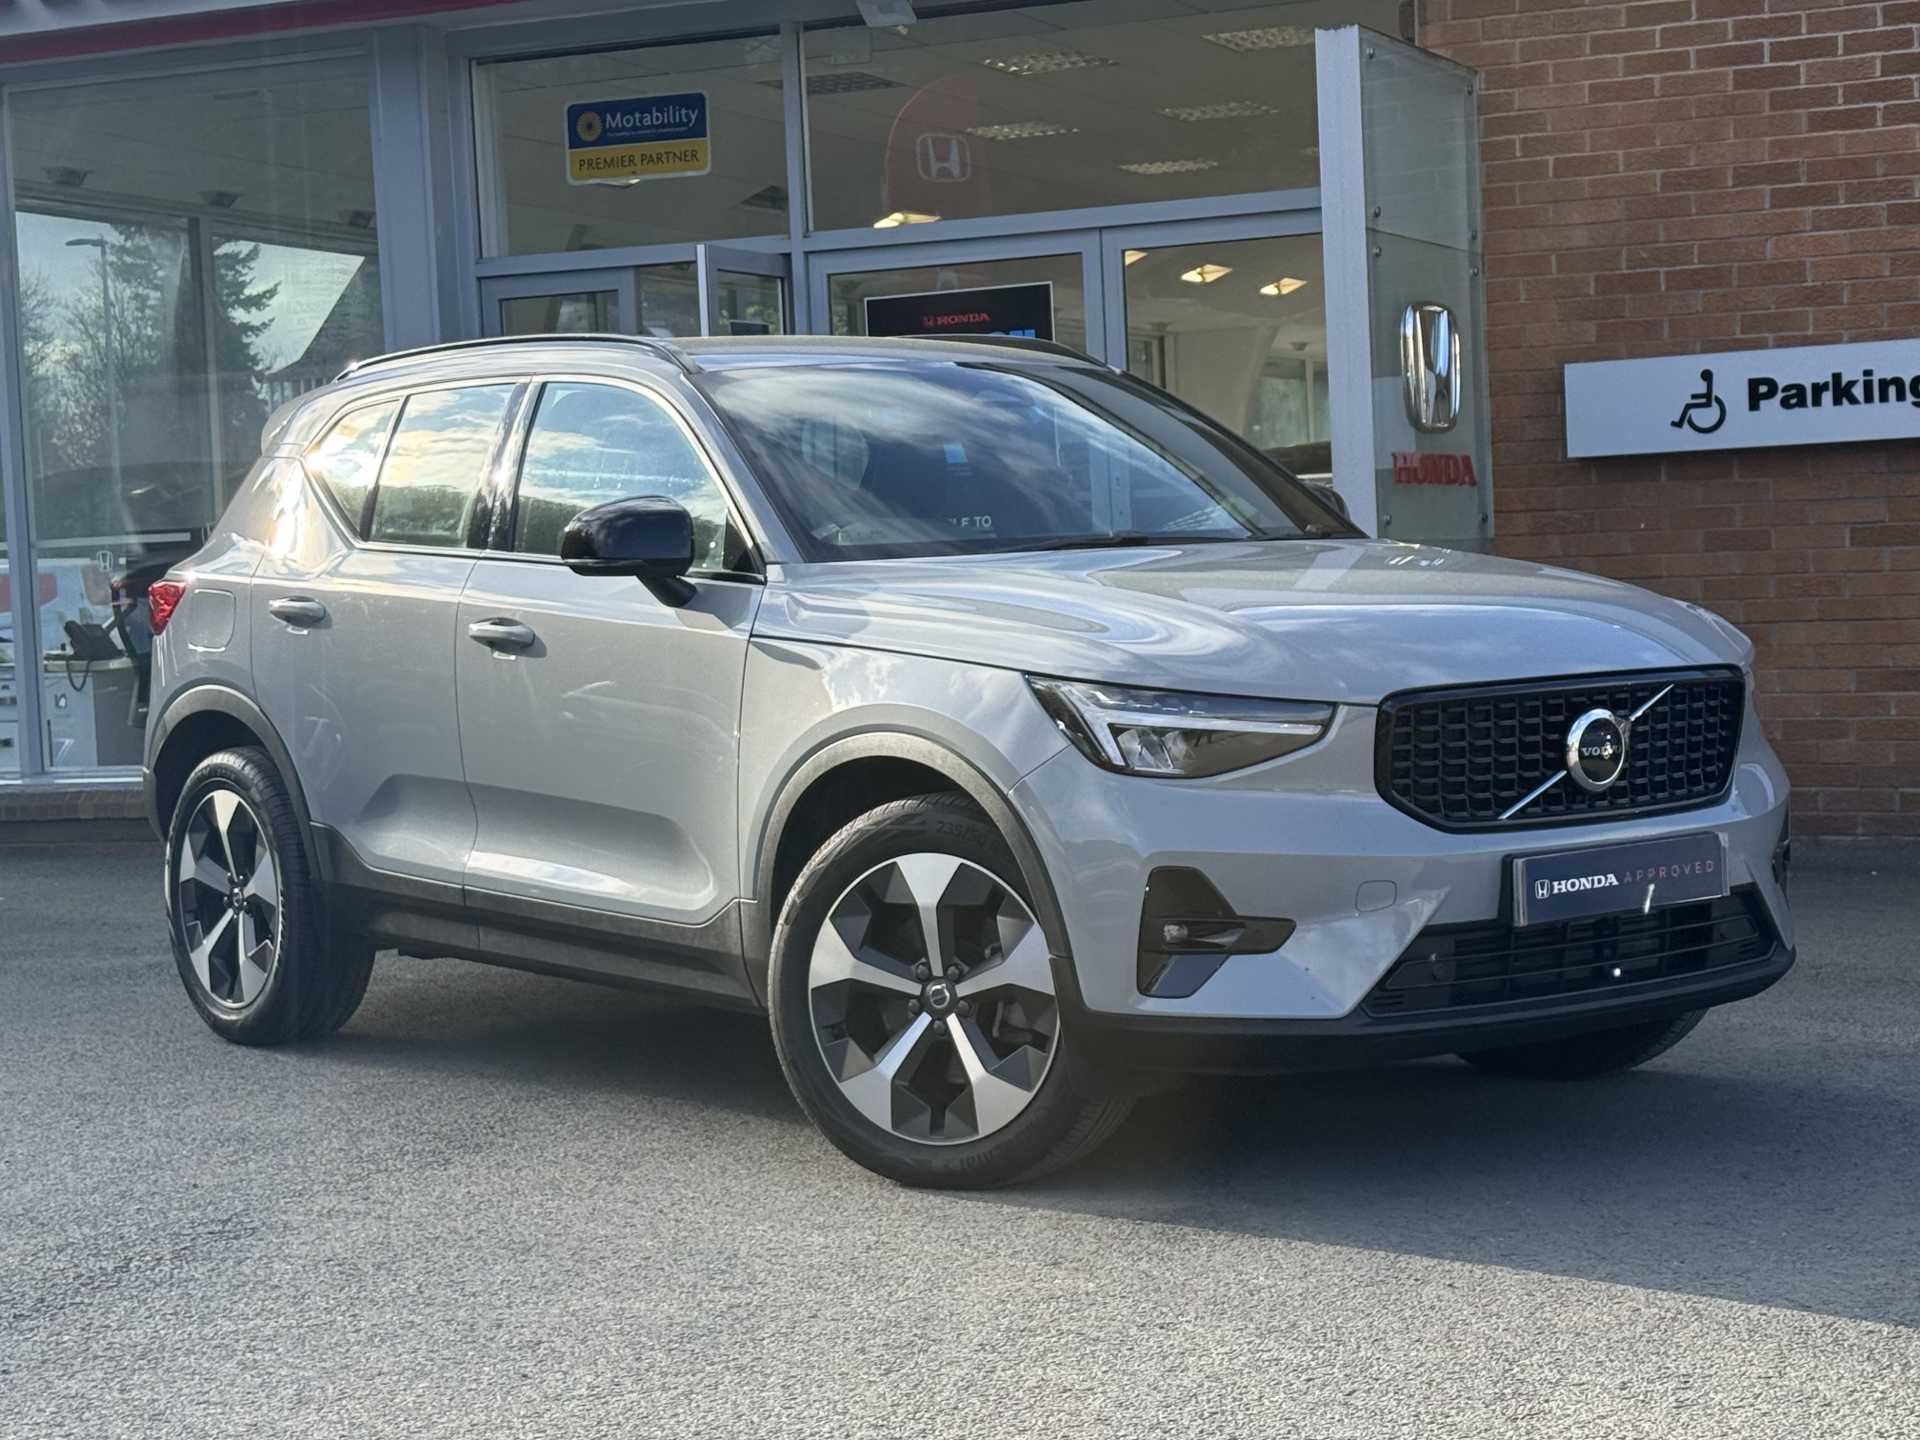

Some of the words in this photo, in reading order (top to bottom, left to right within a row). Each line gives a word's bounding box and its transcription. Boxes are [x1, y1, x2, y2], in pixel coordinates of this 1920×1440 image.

[606, 106, 698, 128] Motability
[579, 154, 637, 171] PREMIER
[640, 149, 699, 166] PARTNER
[937, 312, 990, 326] HONDA
[1392, 452, 1478, 487] HONDA
[973, 515, 992, 528] TO
[1552, 873, 1619, 895] HONDA
[1623, 859, 1715, 883] APPROVED
